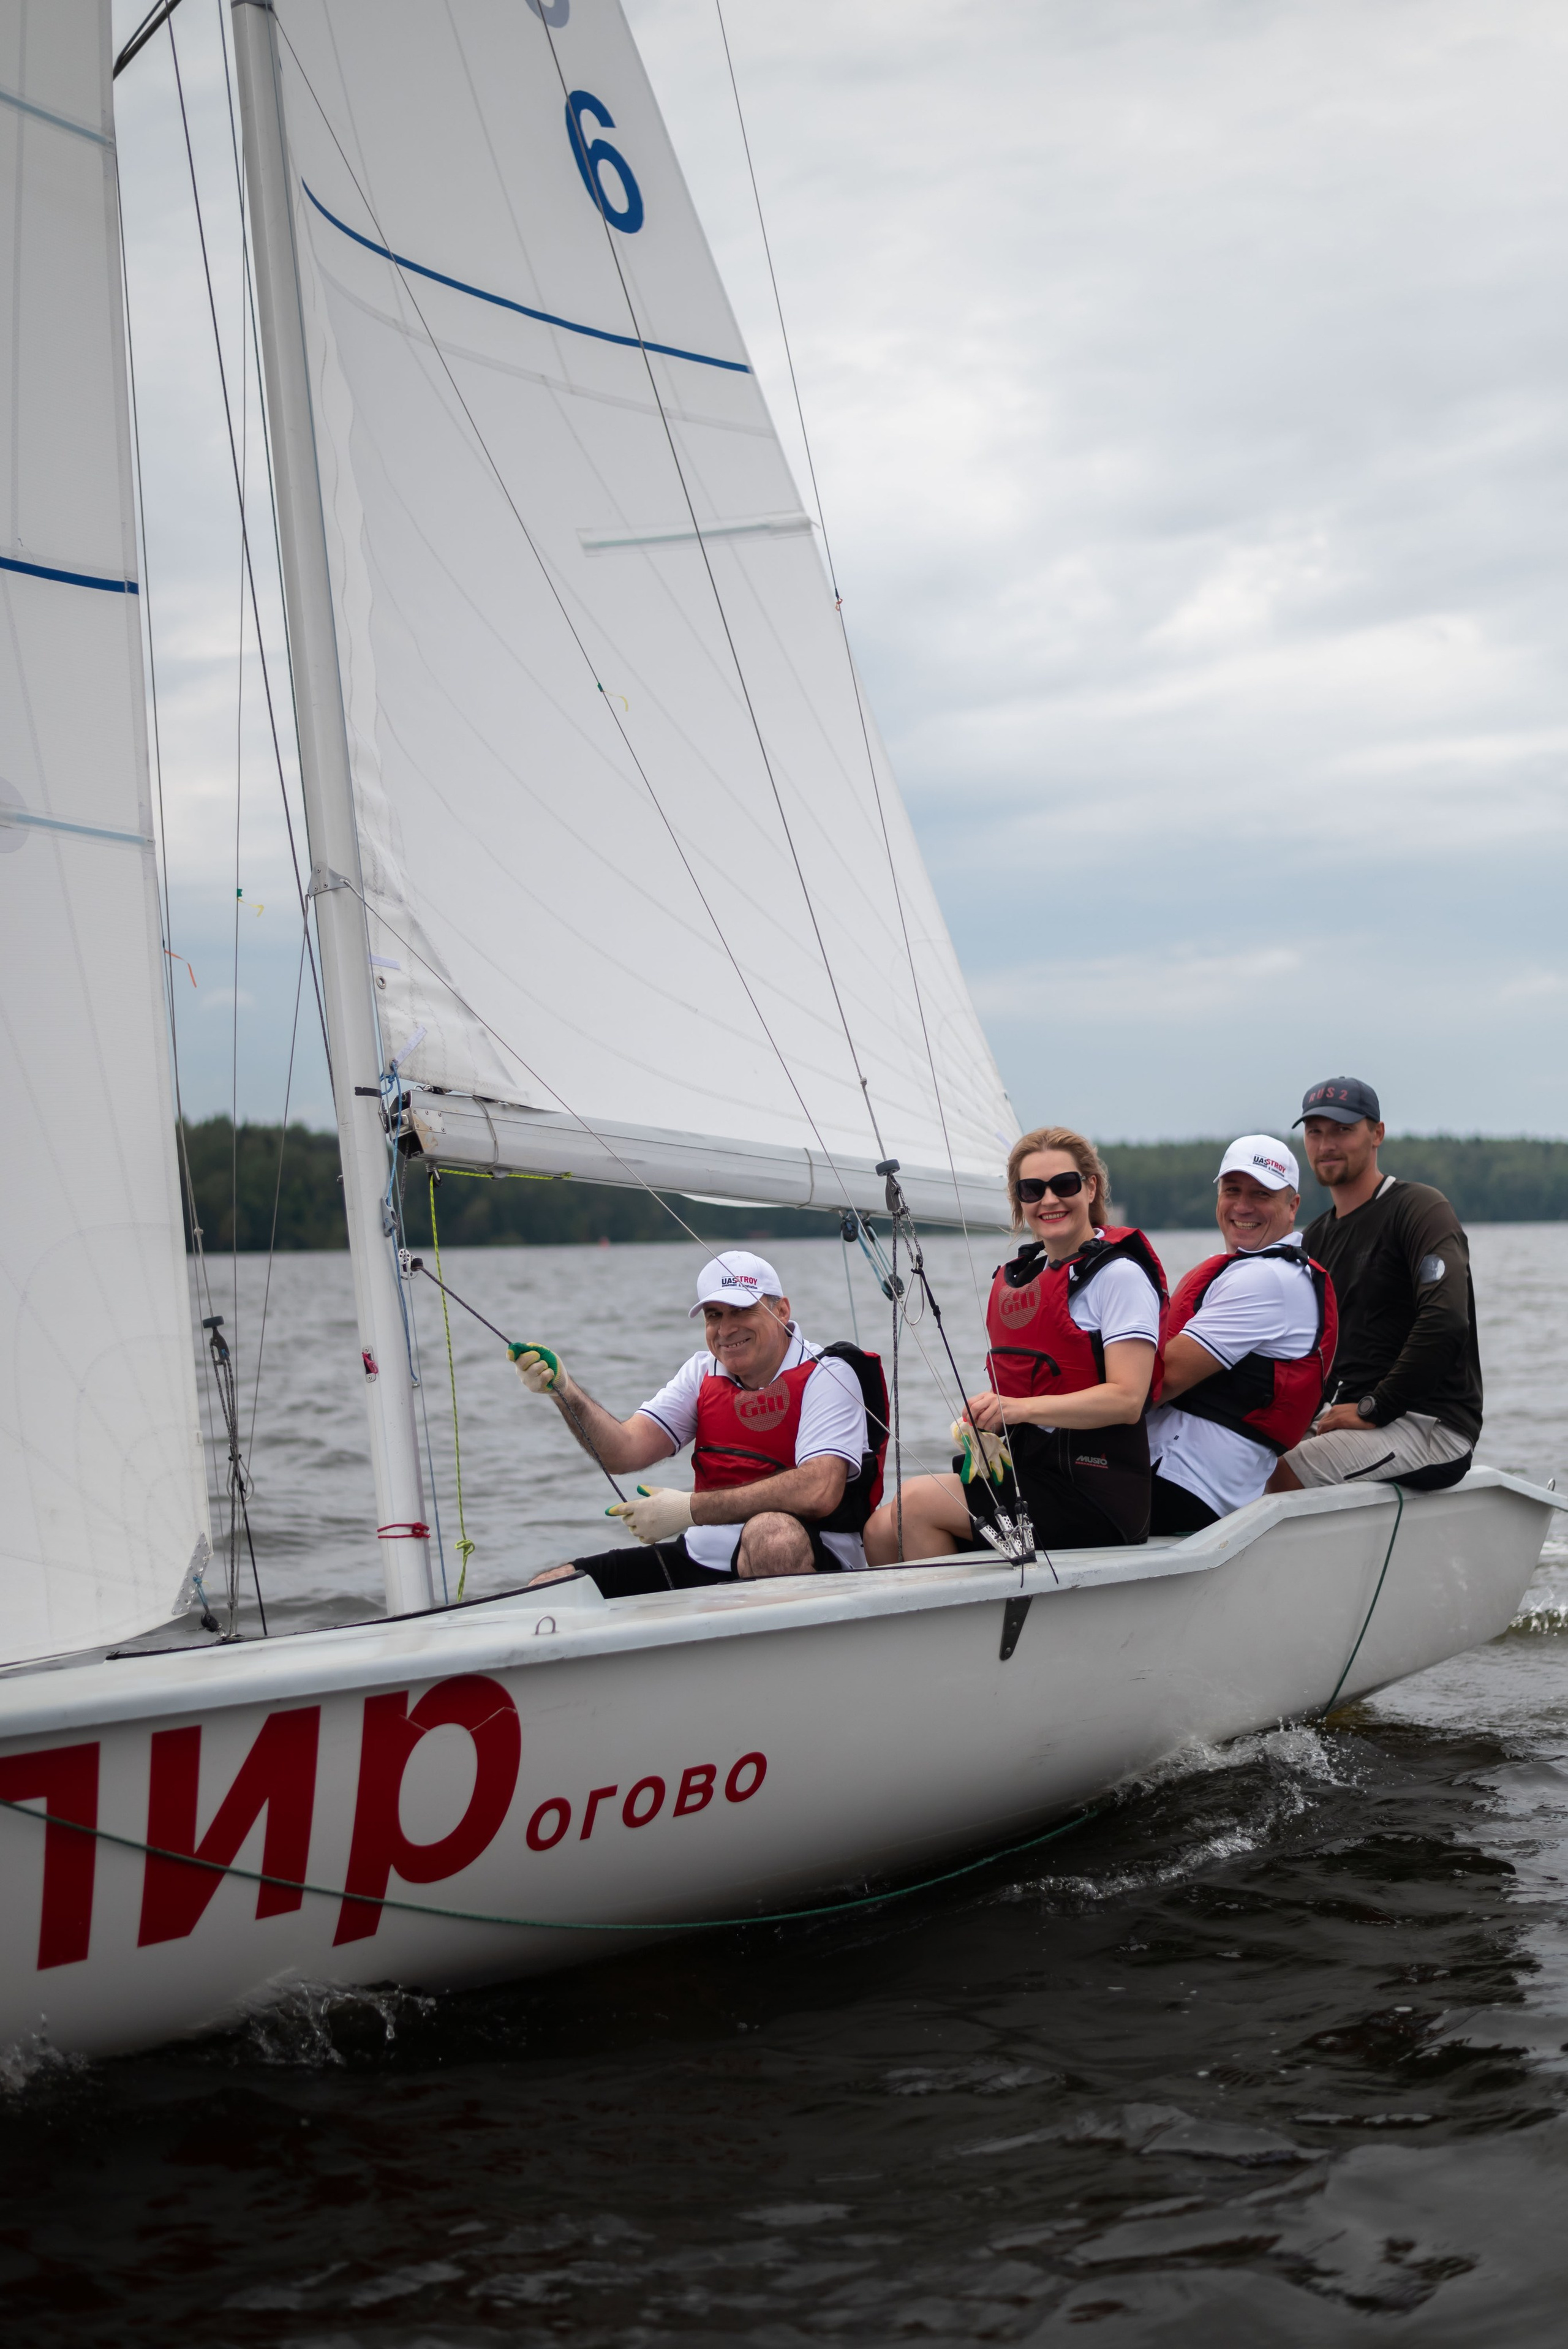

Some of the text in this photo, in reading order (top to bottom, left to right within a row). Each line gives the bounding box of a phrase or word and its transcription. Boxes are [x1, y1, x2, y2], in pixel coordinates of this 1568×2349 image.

[565, 90, 644, 234] 6
[1001, 1291, 1036, 1315] Gill
[739, 1395, 785, 1417] Gill
[1076, 1455, 1108, 1465] MUSTO
